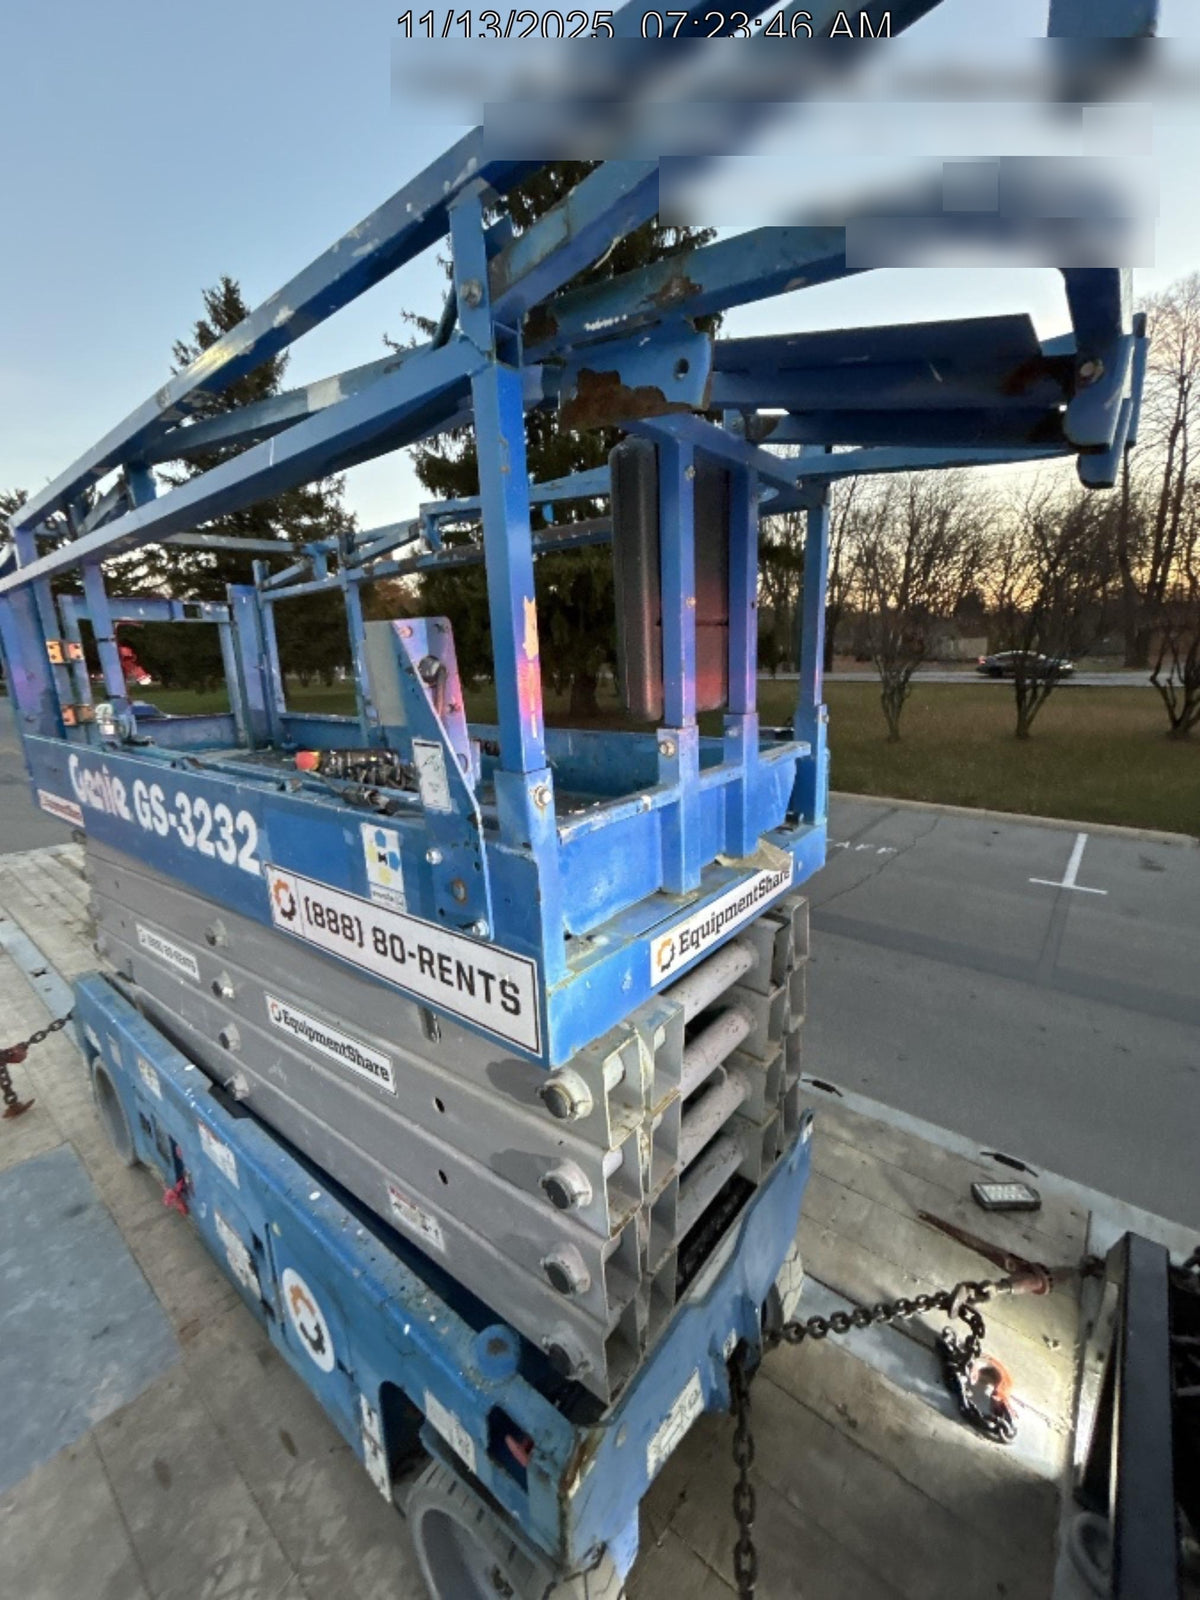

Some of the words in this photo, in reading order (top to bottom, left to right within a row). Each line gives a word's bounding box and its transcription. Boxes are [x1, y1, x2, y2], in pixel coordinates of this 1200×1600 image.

[68, 753, 135, 822] Genie
[133, 779, 261, 876] GS-3232
[303, 896, 364, 948] (888)
[372, 926, 522, 1016] 80-RENTS
[678, 870, 790, 955] EquipmentShare
[281, 1009, 391, 1081] EquipmentShare
